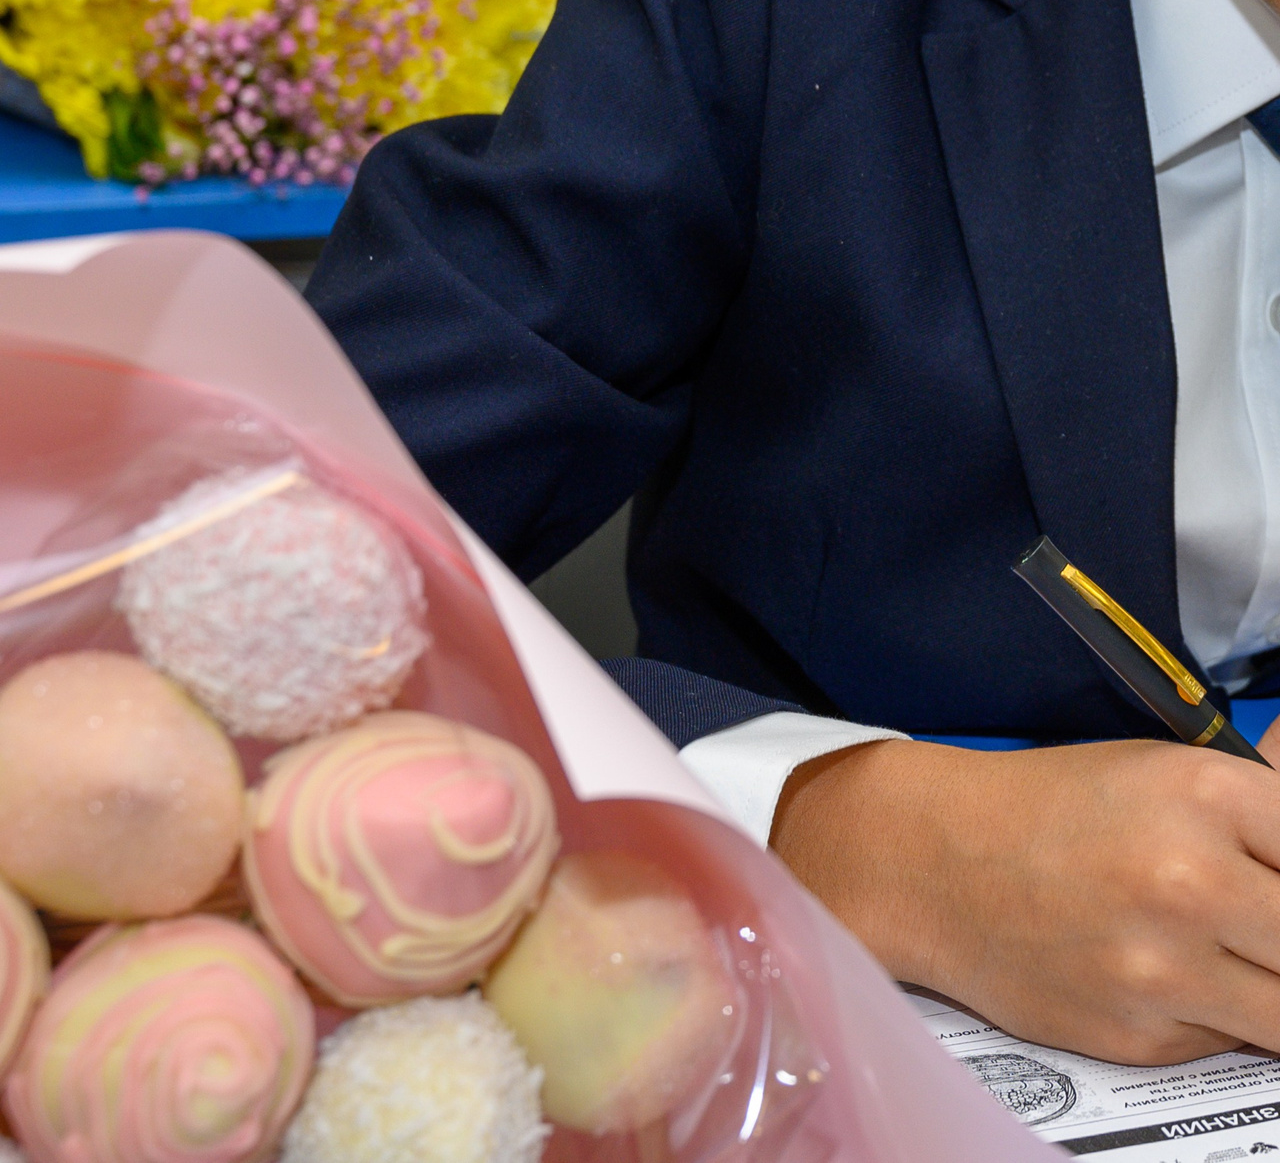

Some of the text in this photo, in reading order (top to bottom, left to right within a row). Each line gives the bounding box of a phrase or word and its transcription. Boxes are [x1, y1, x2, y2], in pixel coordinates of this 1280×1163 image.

[1199, 1070, 1265, 1085] Напиши,
[1200, 1067, 1236, 1077] этим
[1110, 1075, 1185, 1094] друзьями!
[1149, 1087, 1169, 1095] ты
[1172, 1082, 1197, 1091] что
[1188, 1080, 1262, 1097] огромную
[1124, 1093, 1185, 1108] корзину
[1160, 1107, 1279, 1140] ЗНАНИЙ
